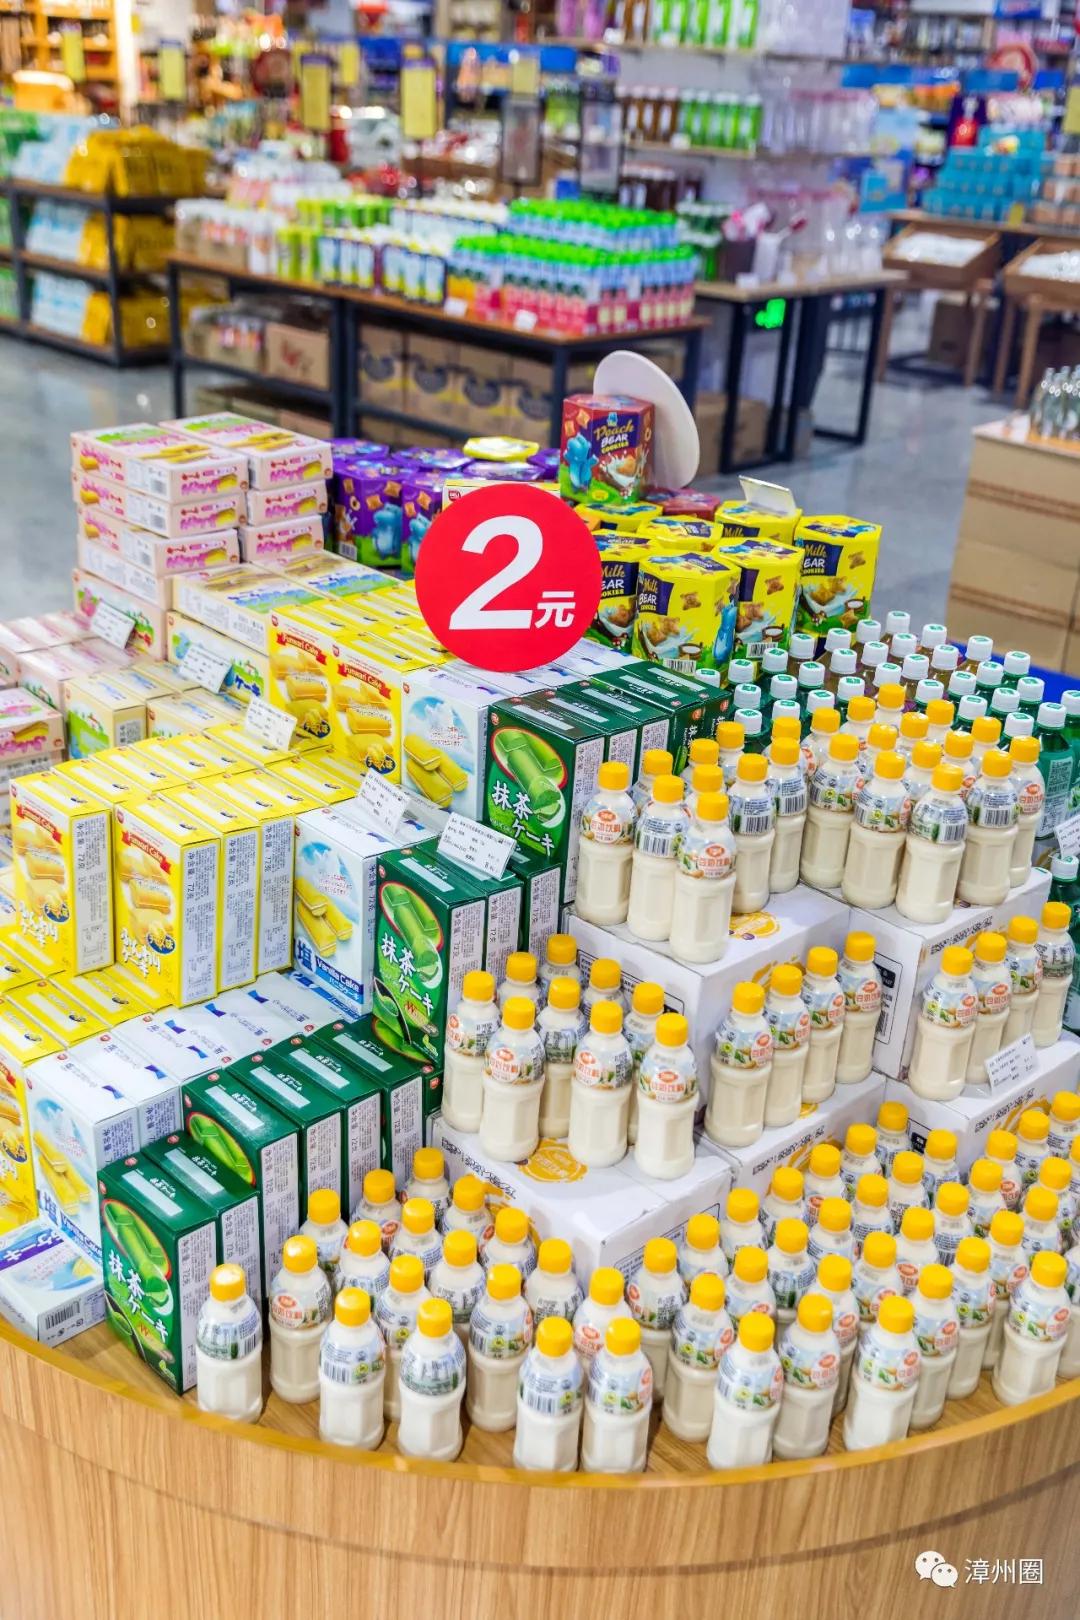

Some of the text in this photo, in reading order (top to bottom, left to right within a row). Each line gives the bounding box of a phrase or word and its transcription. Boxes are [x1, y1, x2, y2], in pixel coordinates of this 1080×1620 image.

[601, 433, 629, 448] BEAR
[803, 558, 826, 568] EAR
[804, 544, 827, 559] Milk
[601, 579, 625, 590] EAR
[491, 780, 535, 821] 抹茶
[511, 820, 555, 857] ケーキ
[381, 932, 417, 979] 抹茶
[340, 976, 360, 993] Cake
[398, 974, 435, 1017] ケーキ
[108, 1249, 145, 1300] 抹茶
[128, 1295, 169, 1344] ケーキ
